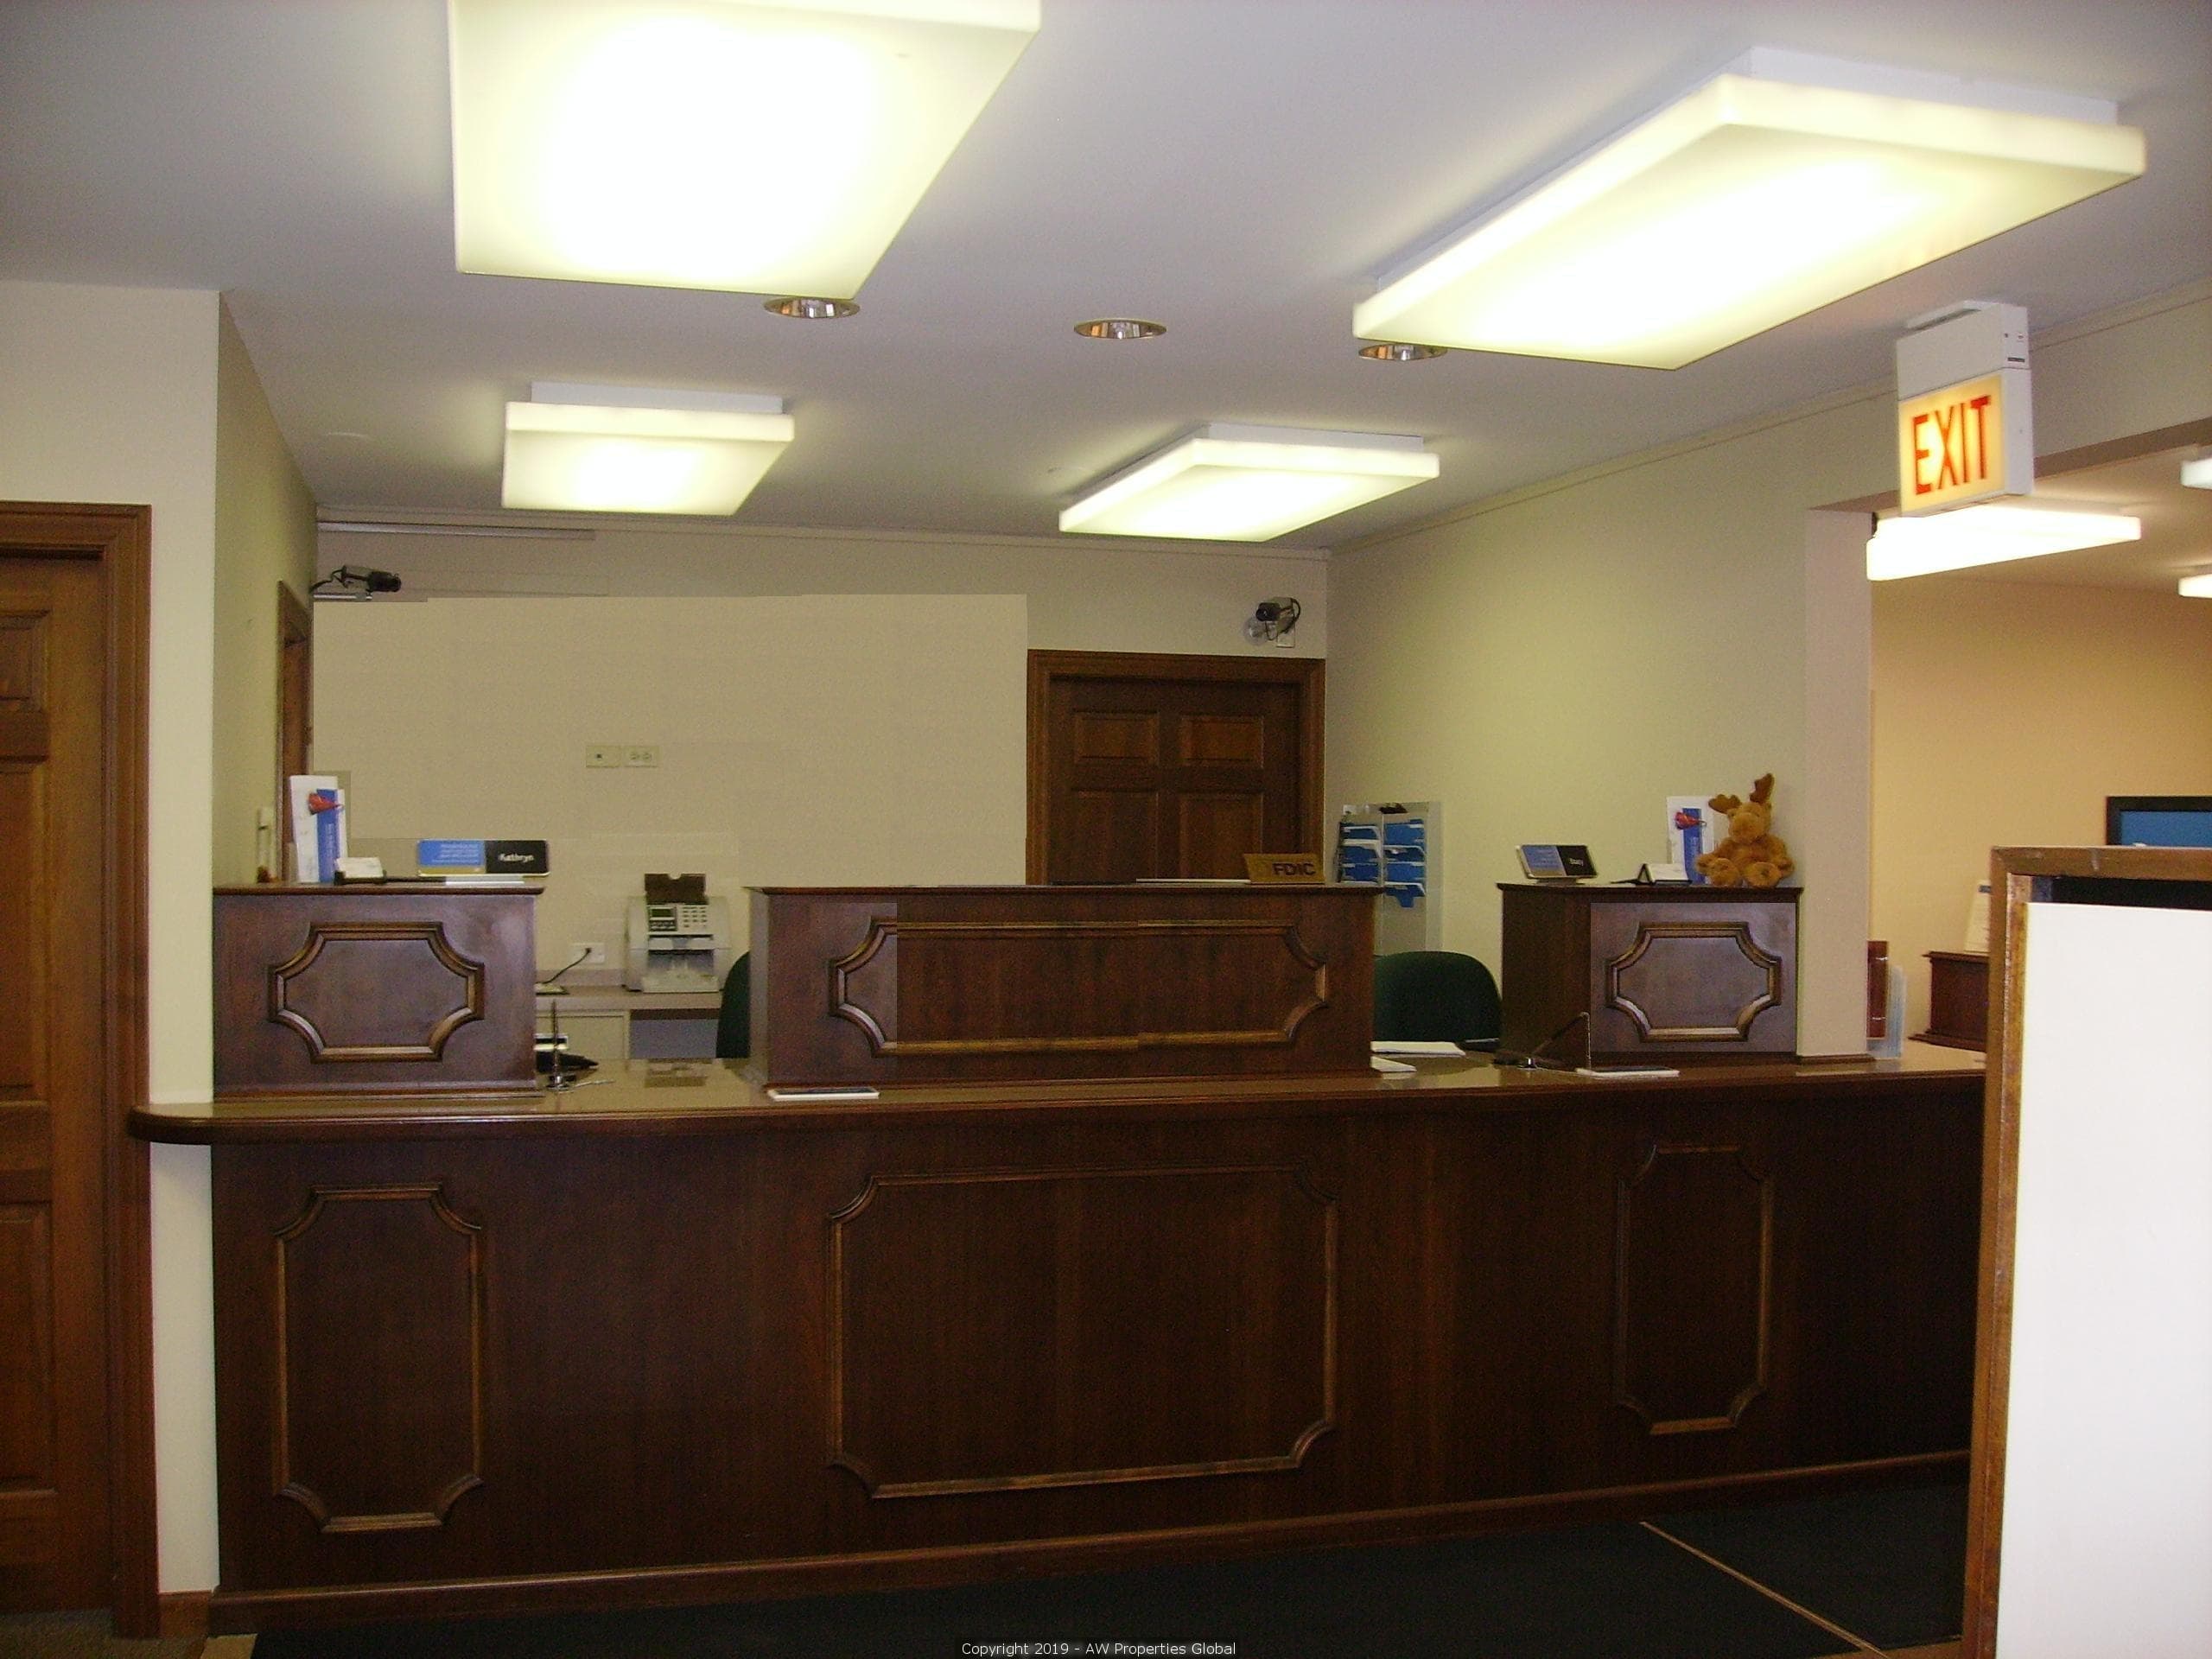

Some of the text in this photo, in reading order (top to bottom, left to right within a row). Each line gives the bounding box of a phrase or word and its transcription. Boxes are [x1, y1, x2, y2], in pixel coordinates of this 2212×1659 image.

[1912, 394, 1992, 495] EXIT
[499, 852, 535, 863] Kathryn
[1272, 861, 1316, 875] FDIC
